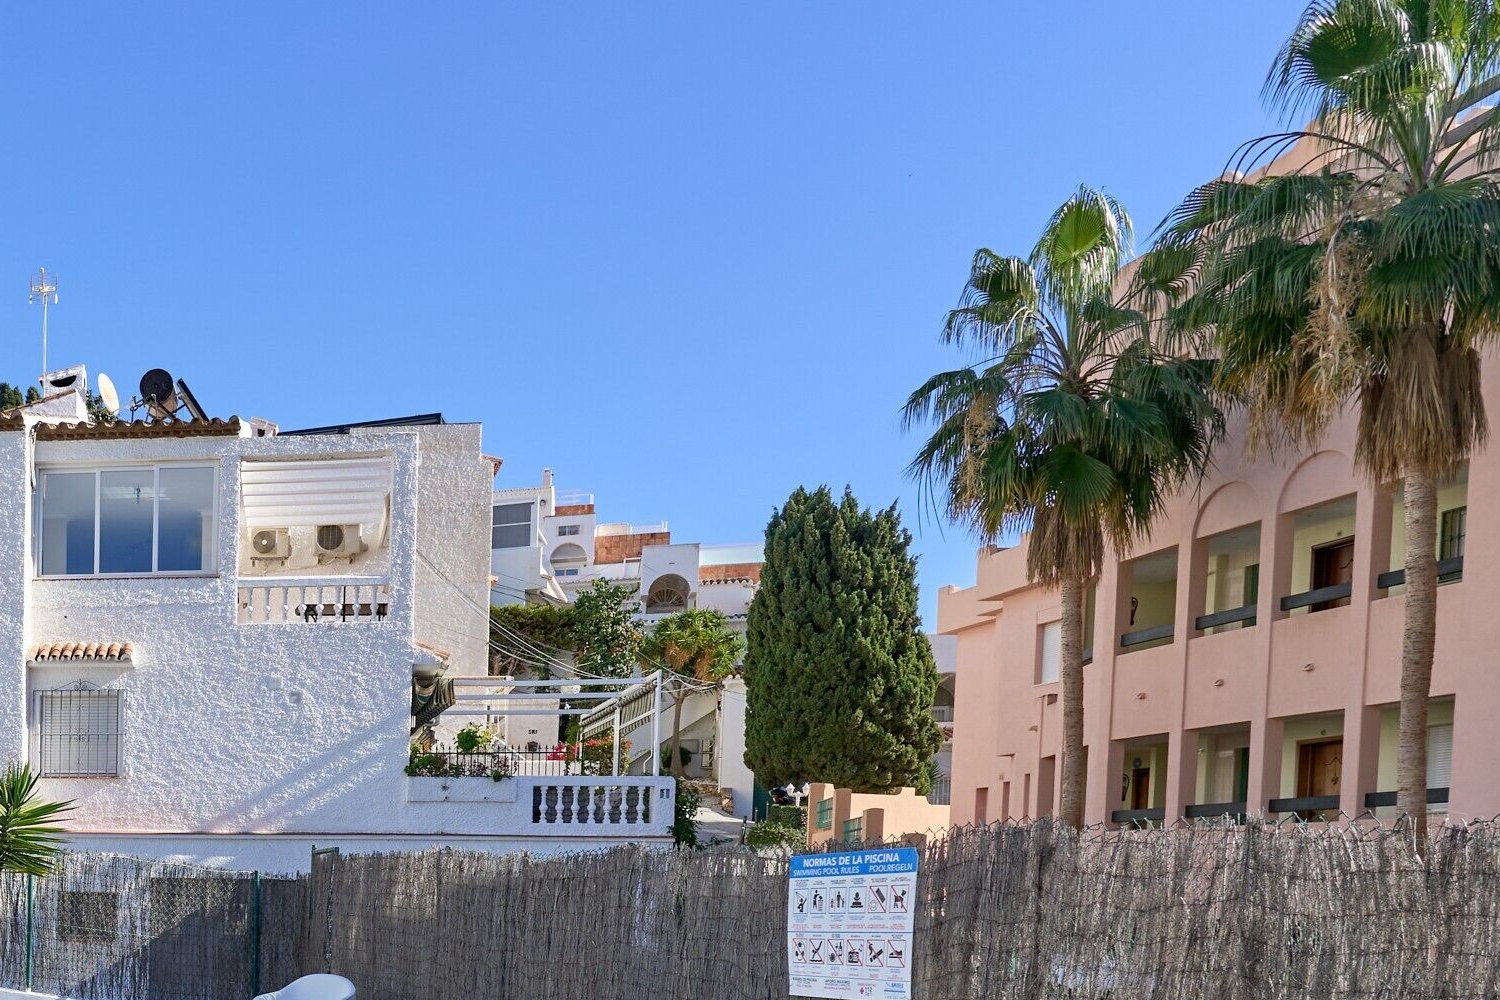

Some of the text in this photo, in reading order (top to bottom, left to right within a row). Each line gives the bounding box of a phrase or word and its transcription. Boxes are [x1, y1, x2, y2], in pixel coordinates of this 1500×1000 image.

[803, 852, 900, 868] NORMAS DE LA PISCINA
[793, 862, 913, 877] SWIMMING POOL RULES POOLREGELN
